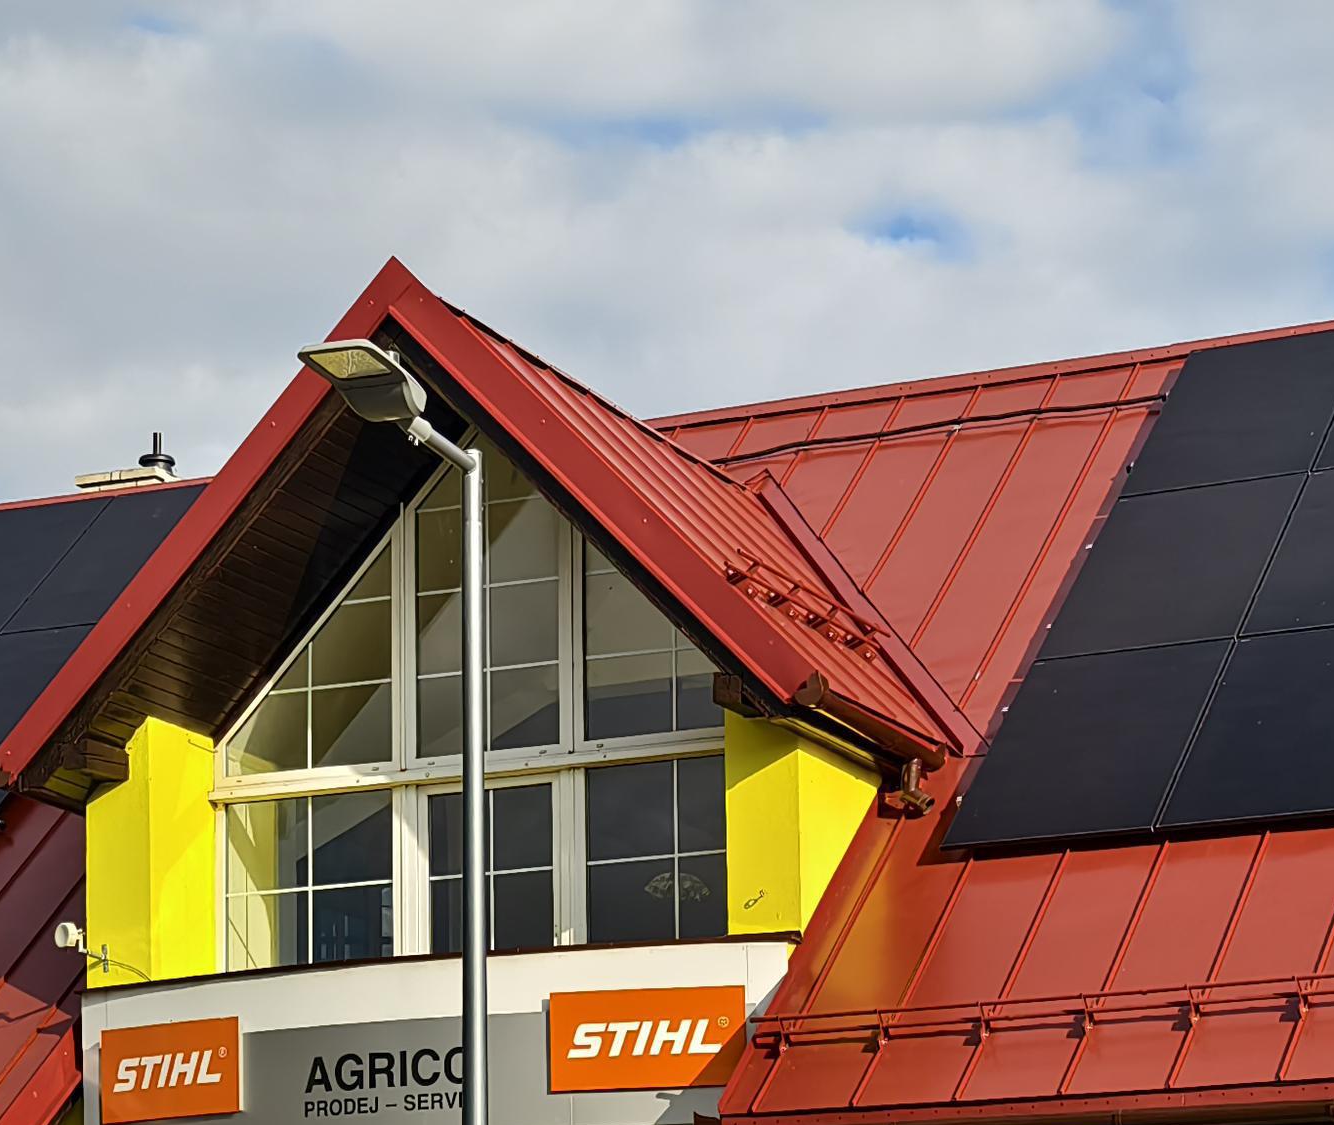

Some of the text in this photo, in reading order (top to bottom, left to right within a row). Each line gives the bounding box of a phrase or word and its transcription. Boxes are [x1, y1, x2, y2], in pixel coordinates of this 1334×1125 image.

[566, 1018, 723, 1059] STIHL
[112, 1049, 222, 1093] STIHL
[304, 1096, 379, 1118] PRODEJ
[403, 1092, 463, 1112] SERVI
